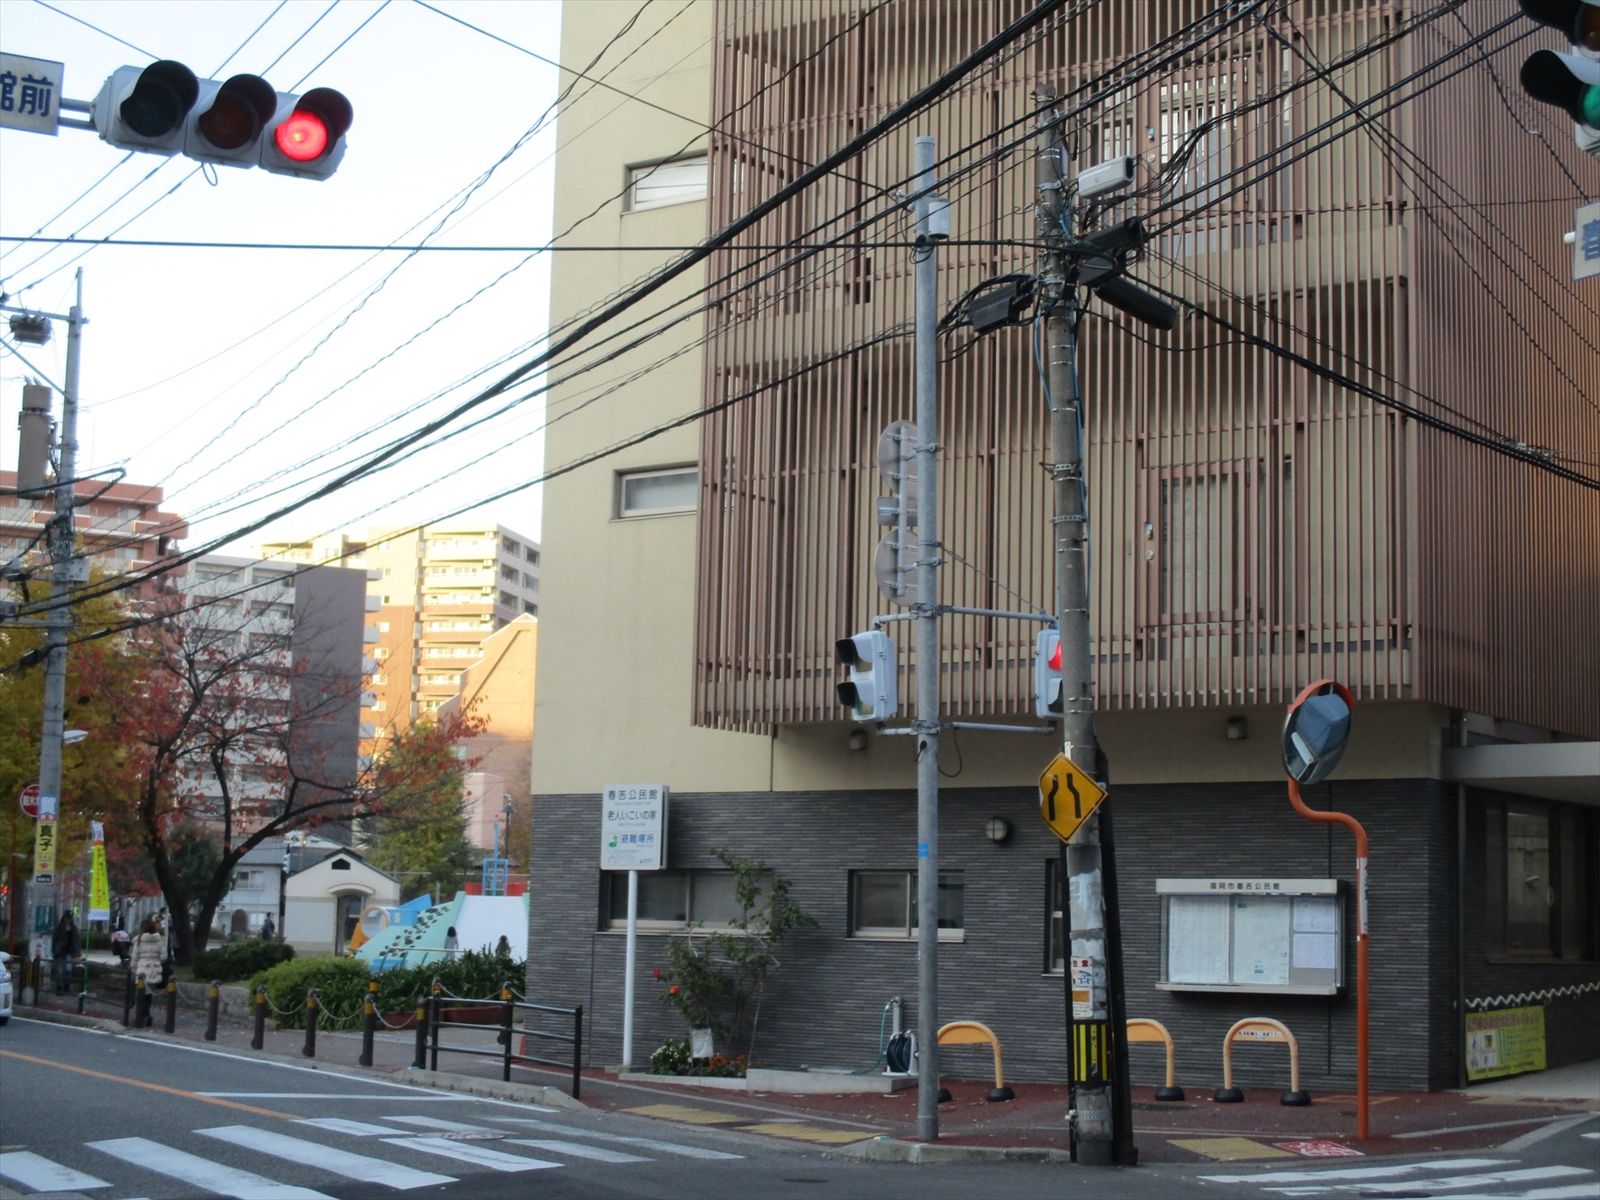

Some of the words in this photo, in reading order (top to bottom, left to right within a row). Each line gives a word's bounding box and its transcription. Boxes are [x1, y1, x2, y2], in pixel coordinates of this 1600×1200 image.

[608, 789, 658, 800] 春吉公民館
[607, 810, 657, 820] 老人いこいの家
[1210, 882, 1280, 890] 福岡市春吉公民館
